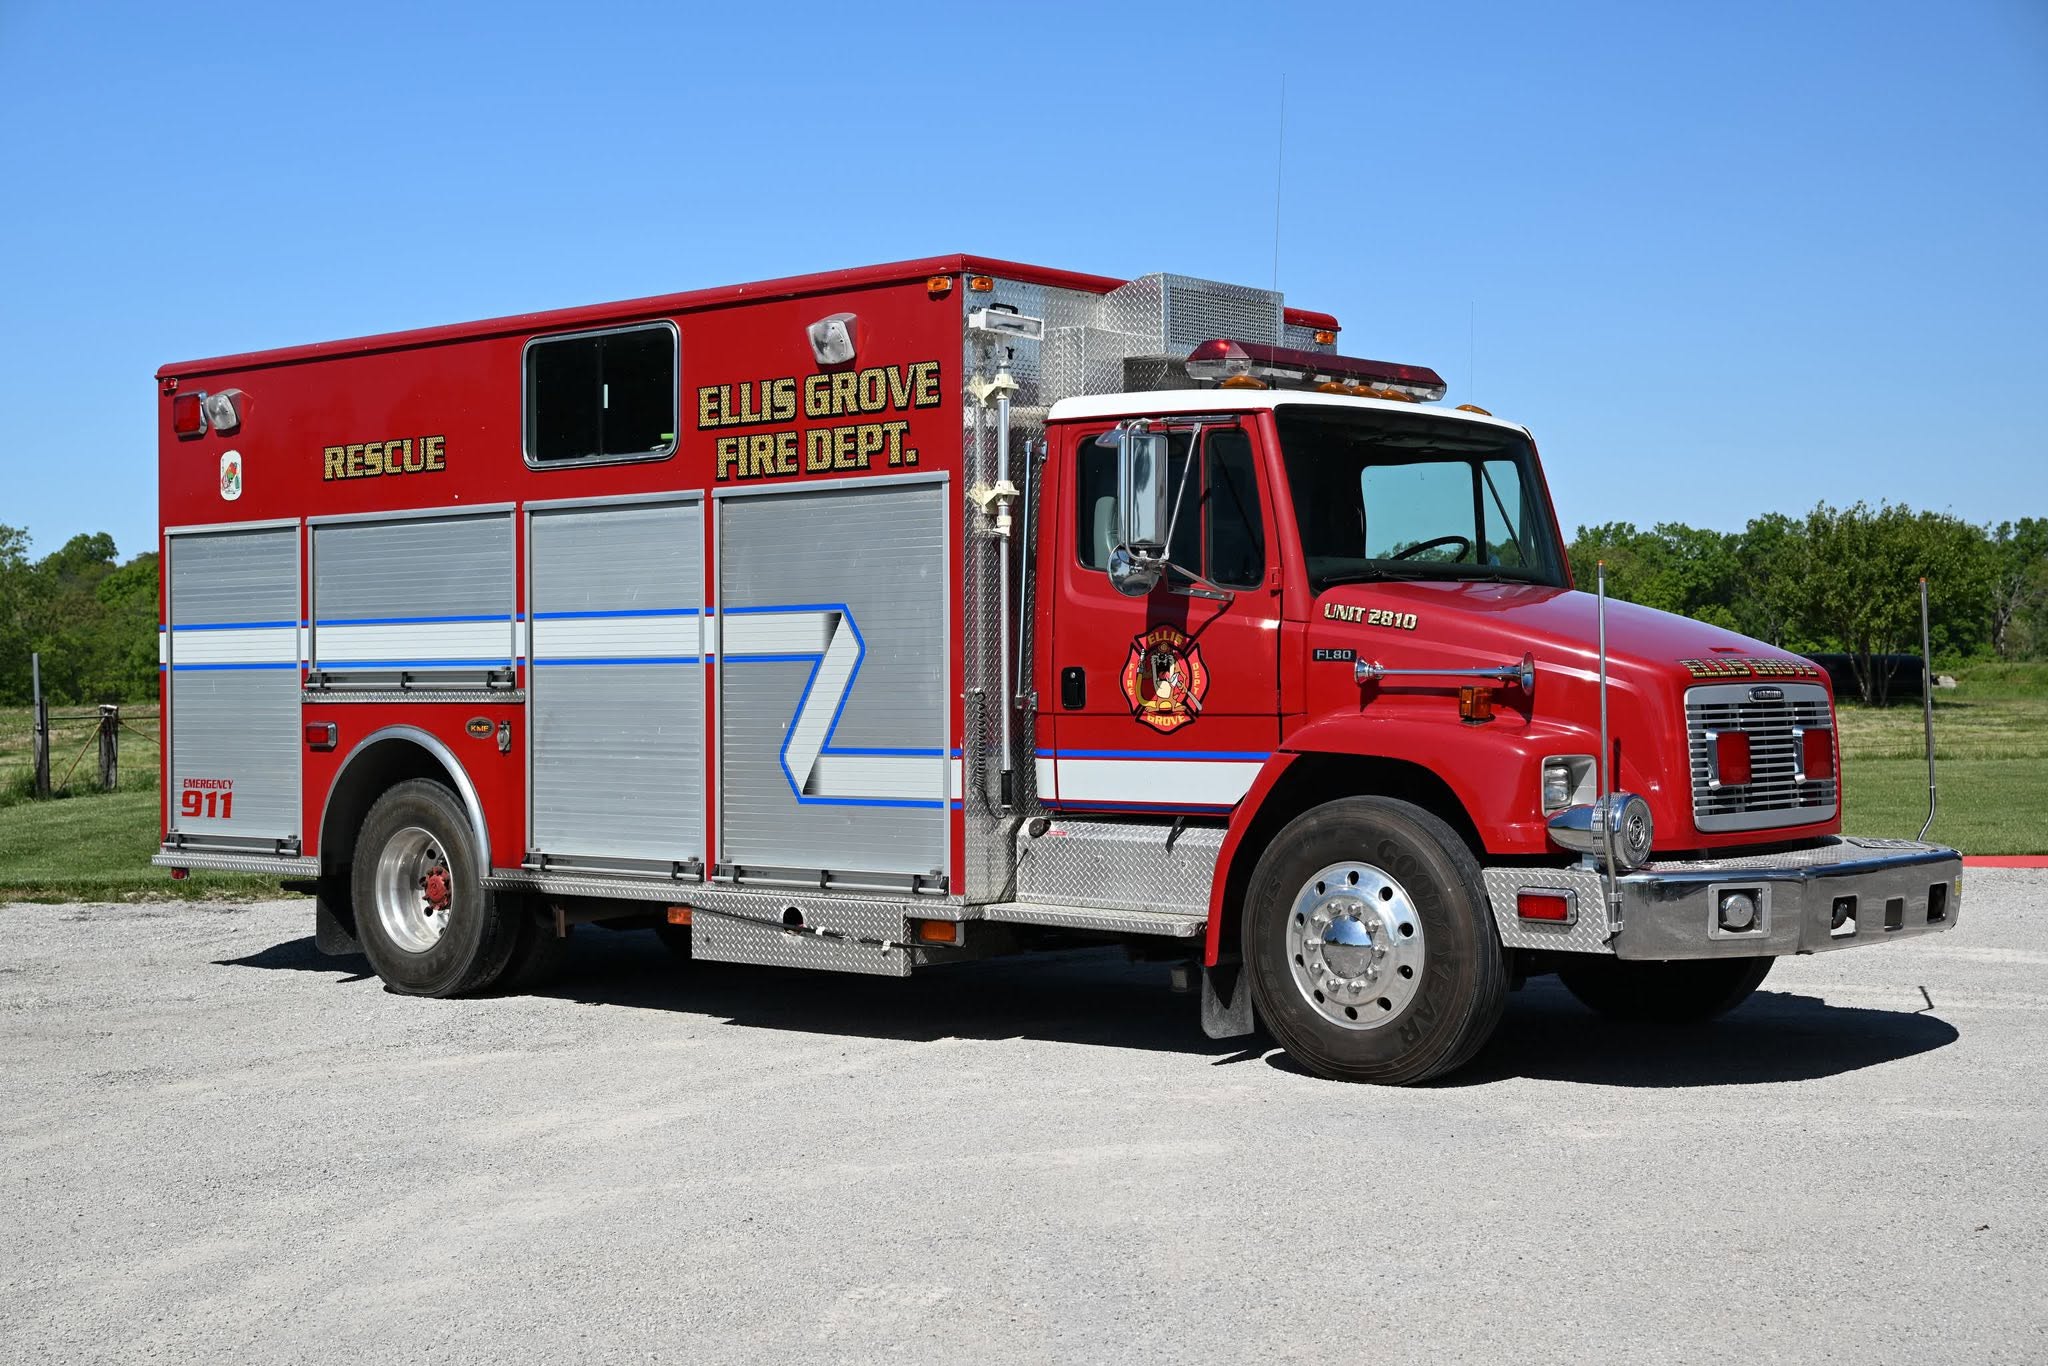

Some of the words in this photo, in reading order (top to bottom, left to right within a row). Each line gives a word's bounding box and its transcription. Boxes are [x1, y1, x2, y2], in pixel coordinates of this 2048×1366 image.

[698, 377, 797, 430] ELLIS
[803, 361, 940, 419] GROVE
[323, 436, 445, 481] RESCUE
[716, 431, 799, 481] FIRE
[805, 420, 918, 474] DEPT.
[1324, 603, 1366, 623] UNIT
[1367, 608, 1418, 631] 2810
[1147, 630, 1184, 647] ELLIS
[1316, 649, 1351, 660] FL80
[1679, 657, 1751, 678] ELLIS
[1126, 662, 1136, 696] FIRE
[1192, 661, 1201, 695] DEPT
[470, 724, 489, 732] KME
[1146, 714, 1187, 727] GROVE
[183, 778, 234, 790] EMERGENCY
[181, 790, 232, 818] 911
